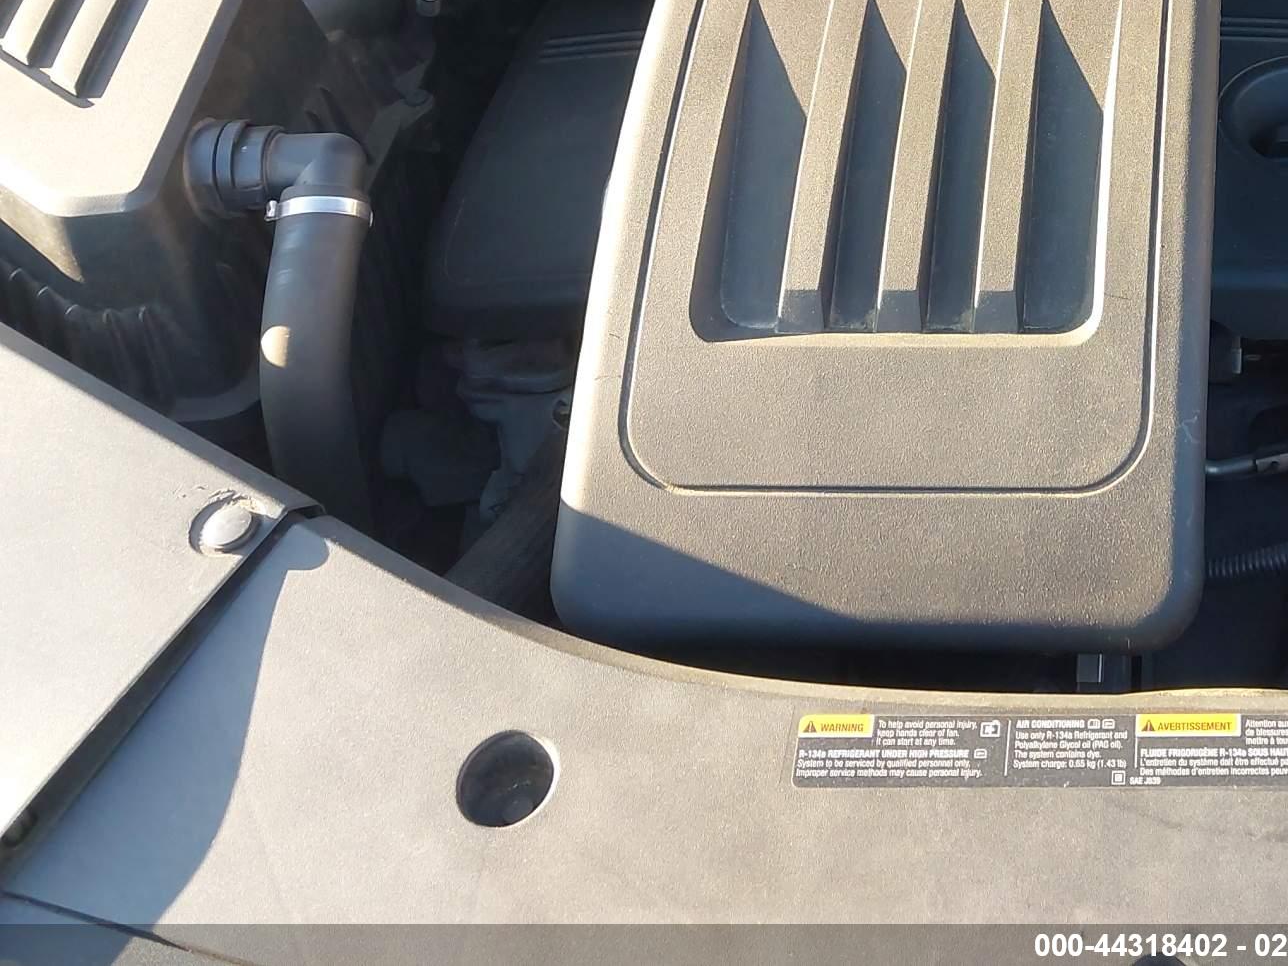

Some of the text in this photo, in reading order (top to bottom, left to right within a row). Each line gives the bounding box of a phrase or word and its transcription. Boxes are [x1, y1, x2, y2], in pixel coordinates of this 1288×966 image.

[820, 723, 864, 732] WARNING
[1158, 722, 1232, 730] AVERTISSEMENT
[876, 760, 885, 769] by
[1086, 760, 1096, 769] kg
